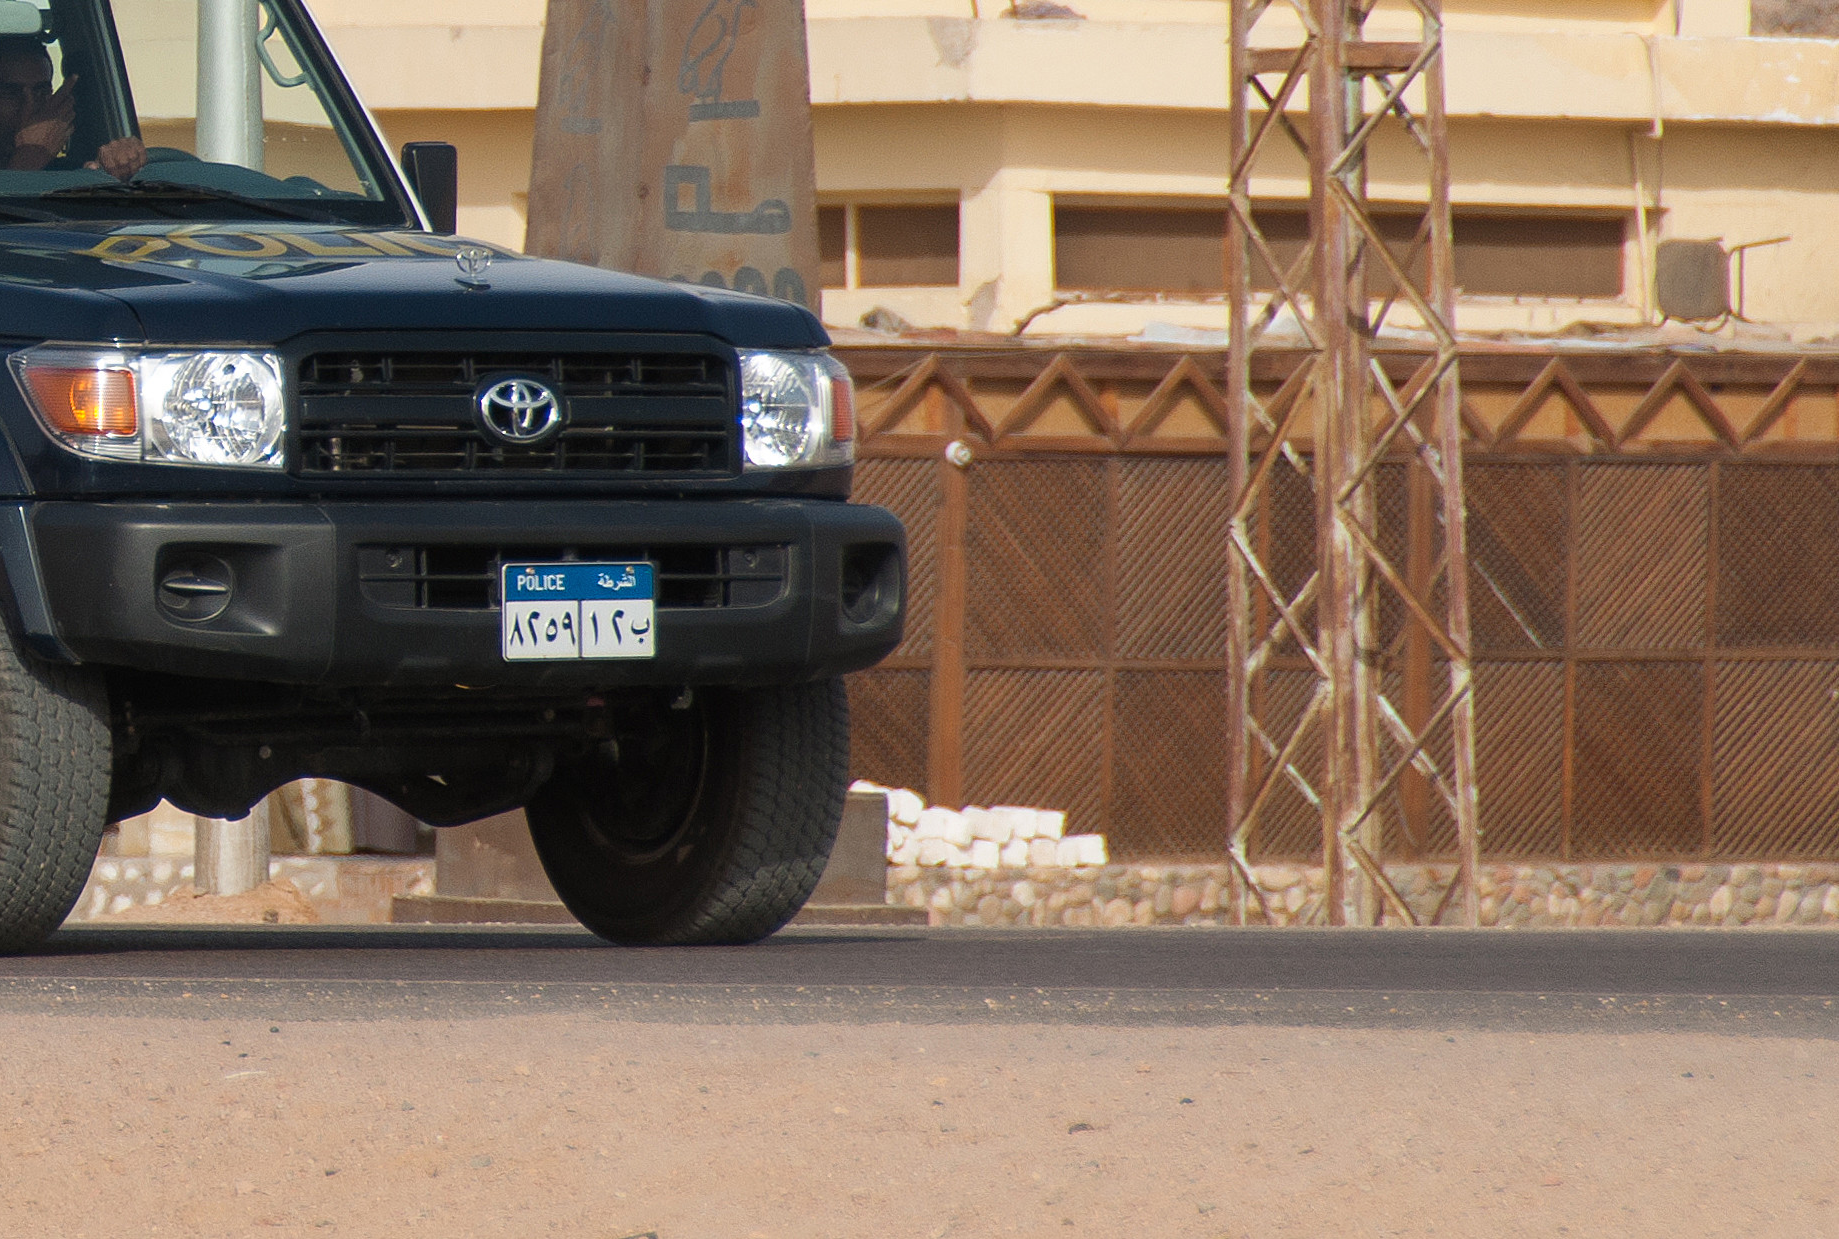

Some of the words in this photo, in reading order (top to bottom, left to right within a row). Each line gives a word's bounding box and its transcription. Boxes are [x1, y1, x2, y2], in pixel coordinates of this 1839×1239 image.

[517, 574, 565, 591] POLICE
[597, 572, 636, 591] الشرطة
[509, 610, 576, 646] ٨٢٥٩
